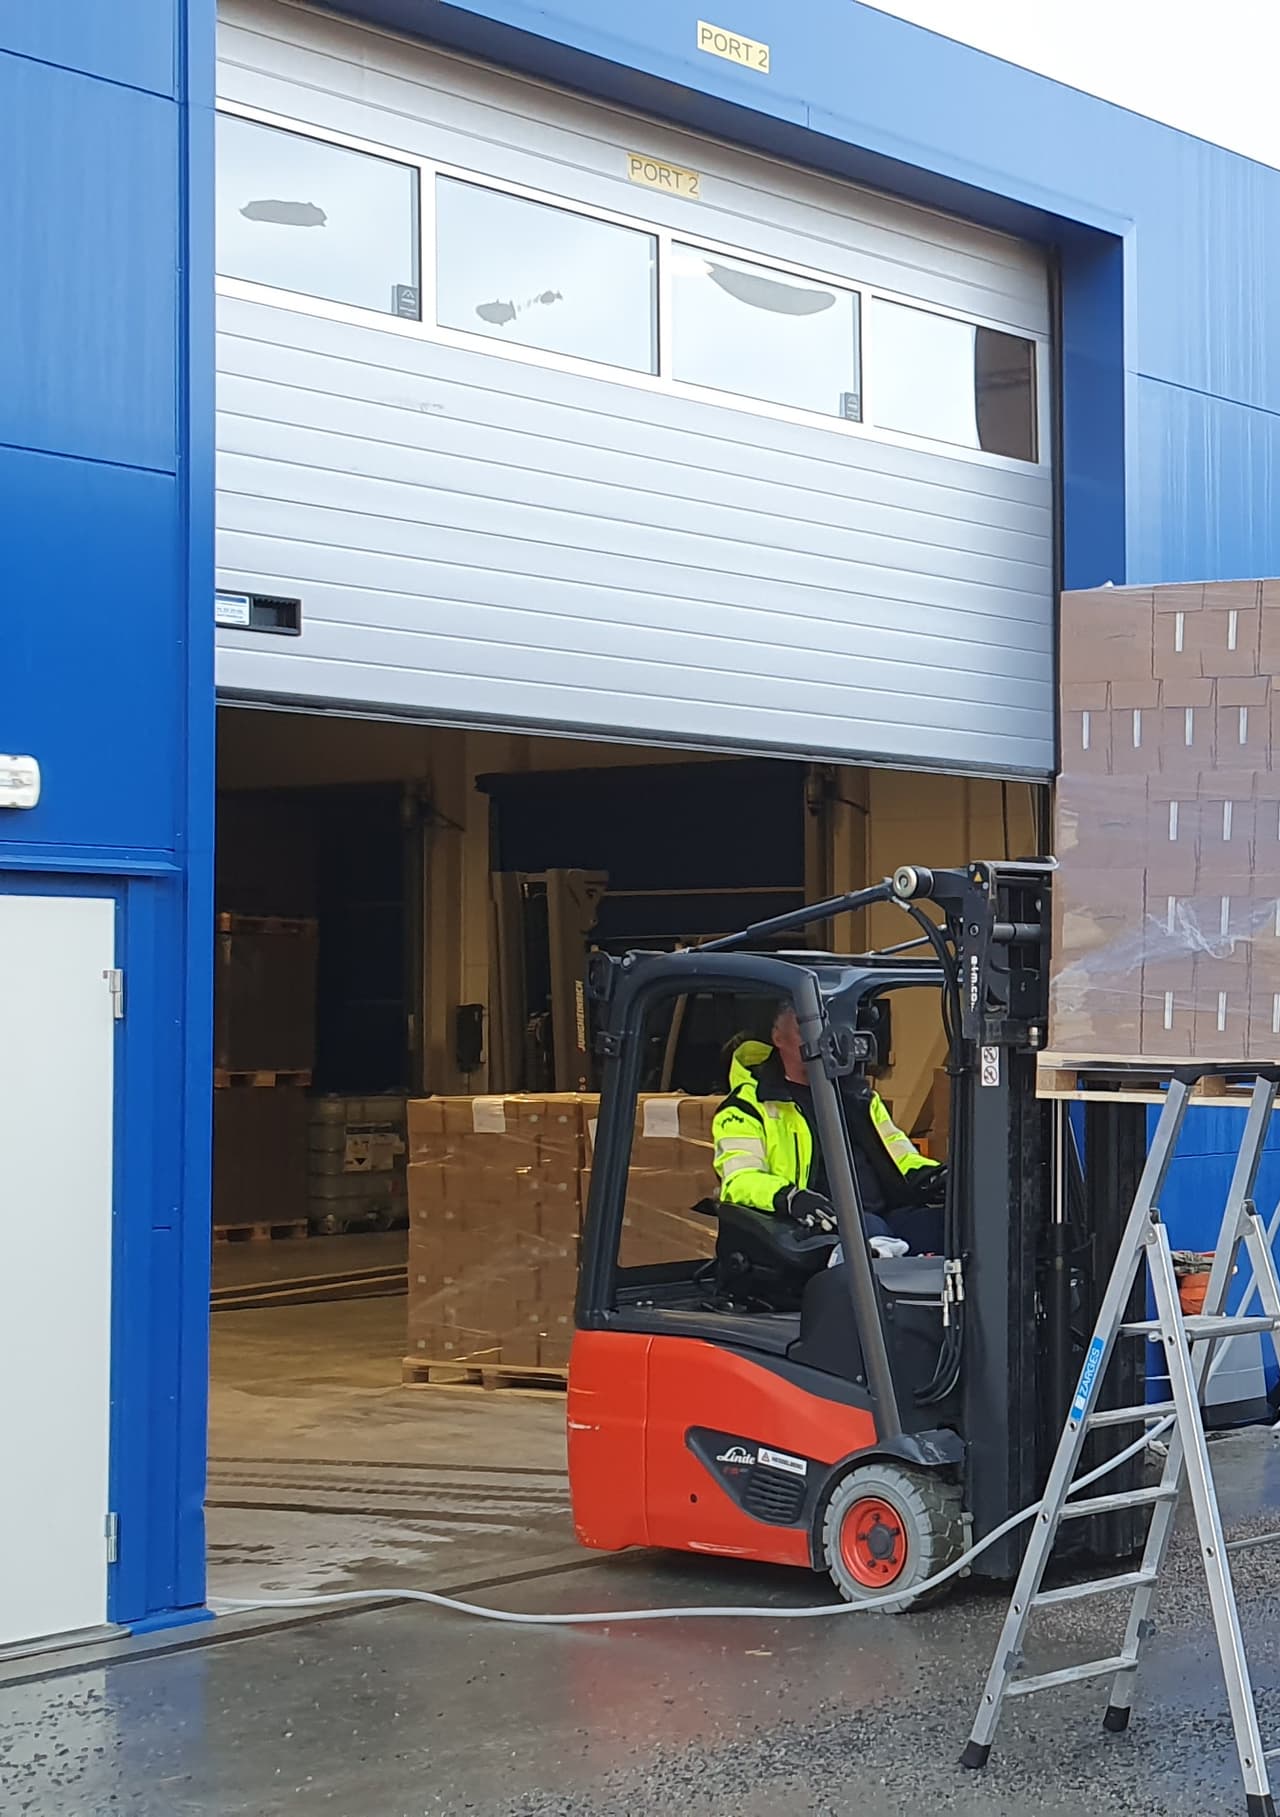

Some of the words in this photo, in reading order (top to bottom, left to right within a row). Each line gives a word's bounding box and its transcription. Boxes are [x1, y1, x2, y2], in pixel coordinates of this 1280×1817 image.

[701, 27, 753, 62] PORT
[758, 49, 768, 68] 2
[630, 158, 683, 189] PORT
[688, 177, 699, 195] 2
[1080, 1347, 1100, 1398] ZARGES
[716, 1446, 756, 1465] Linde
